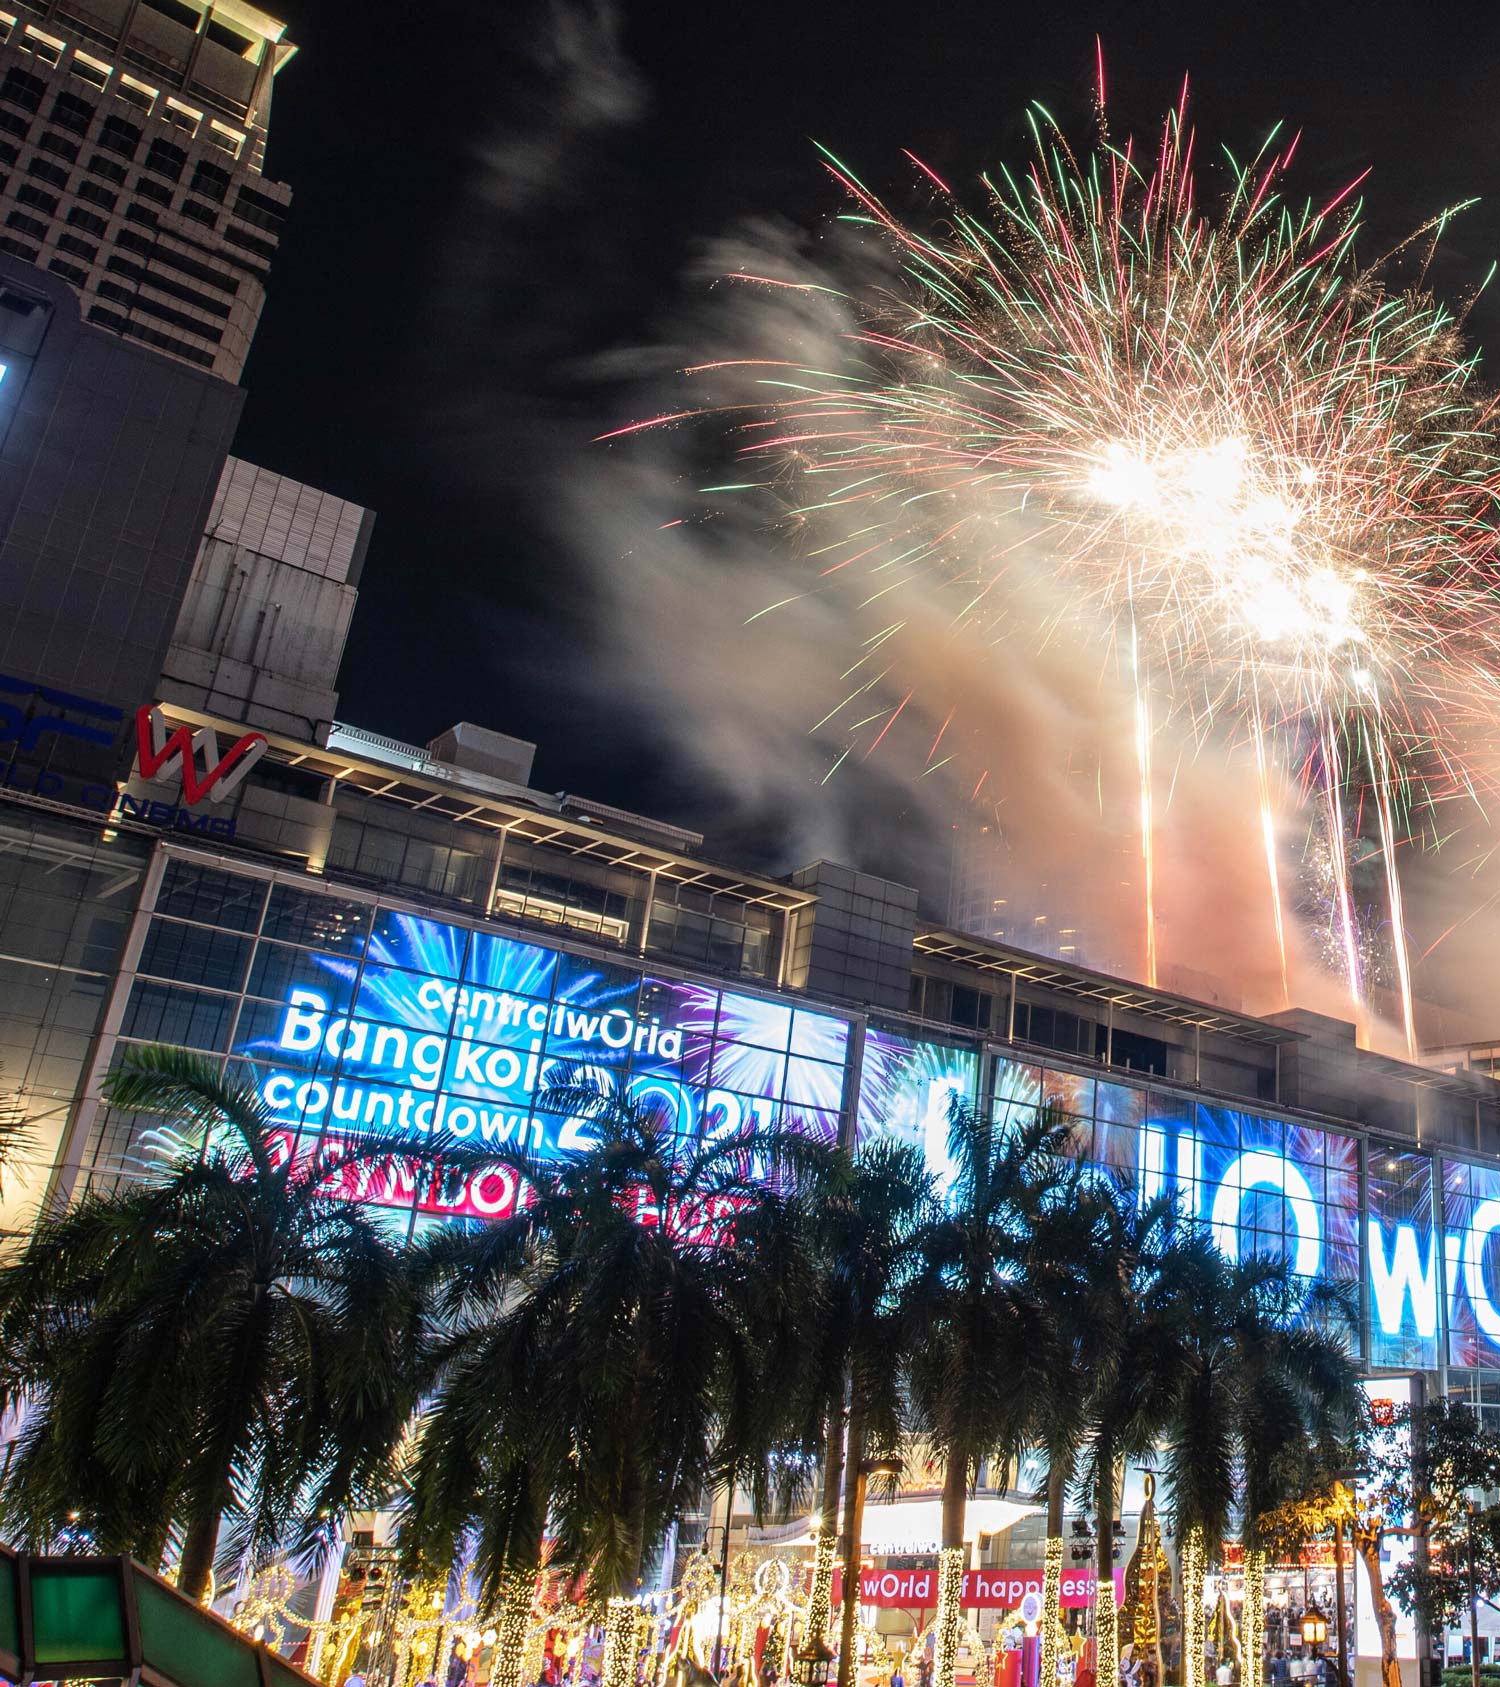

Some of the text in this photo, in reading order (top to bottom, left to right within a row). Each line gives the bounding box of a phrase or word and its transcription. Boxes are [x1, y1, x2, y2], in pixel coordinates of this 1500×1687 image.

[280, 989, 552, 1092] Bangkok
[263, 1071, 544, 1149] countdown
[864, 1573, 929, 1598] wOrld
[976, 1574, 1095, 1604] happiess
